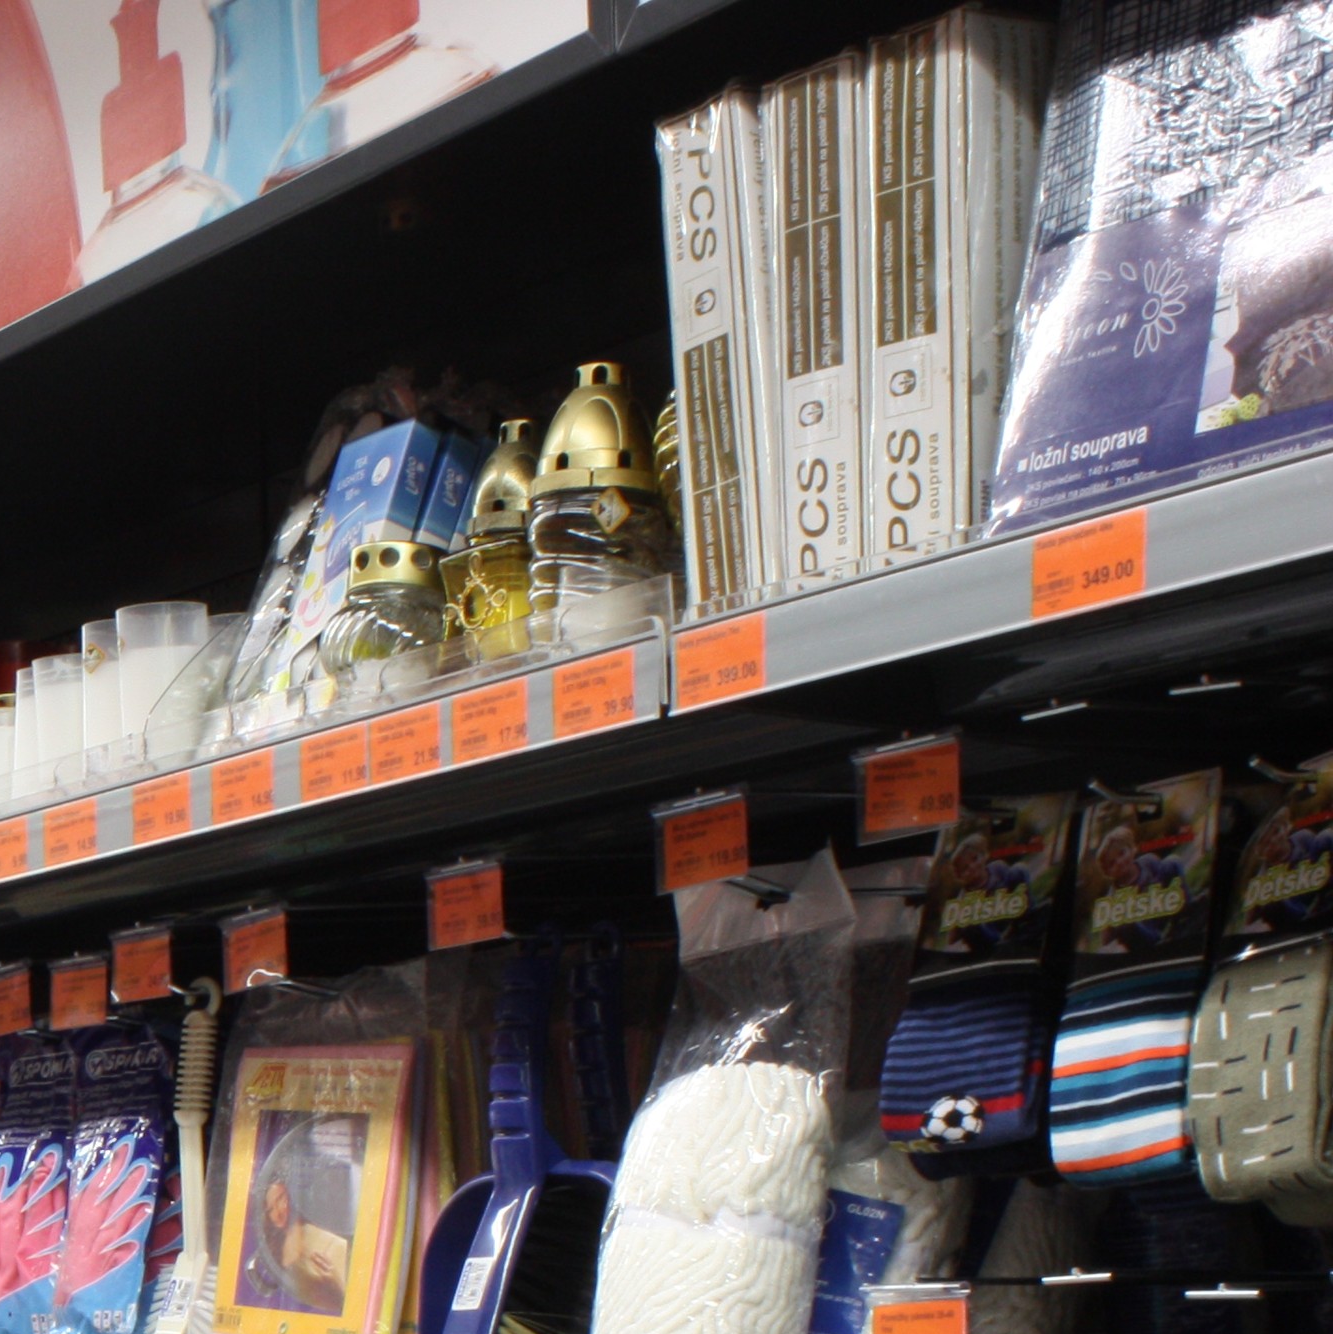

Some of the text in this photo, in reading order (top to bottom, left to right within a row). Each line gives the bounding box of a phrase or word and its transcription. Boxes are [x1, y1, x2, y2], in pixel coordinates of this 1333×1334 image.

[929, 432, 939, 519] souprava
[1028, 425, 1149, 475] ložní souprava
[796, 458, 829, 590] PCS
[834, 461, 847, 546] souprava
[885, 428, 921, 566] PCS
[1081, 558, 1135, 589] 349.00
[603, 693, 635, 718] 39.90
[715, 660, 757, 687] 399.00
